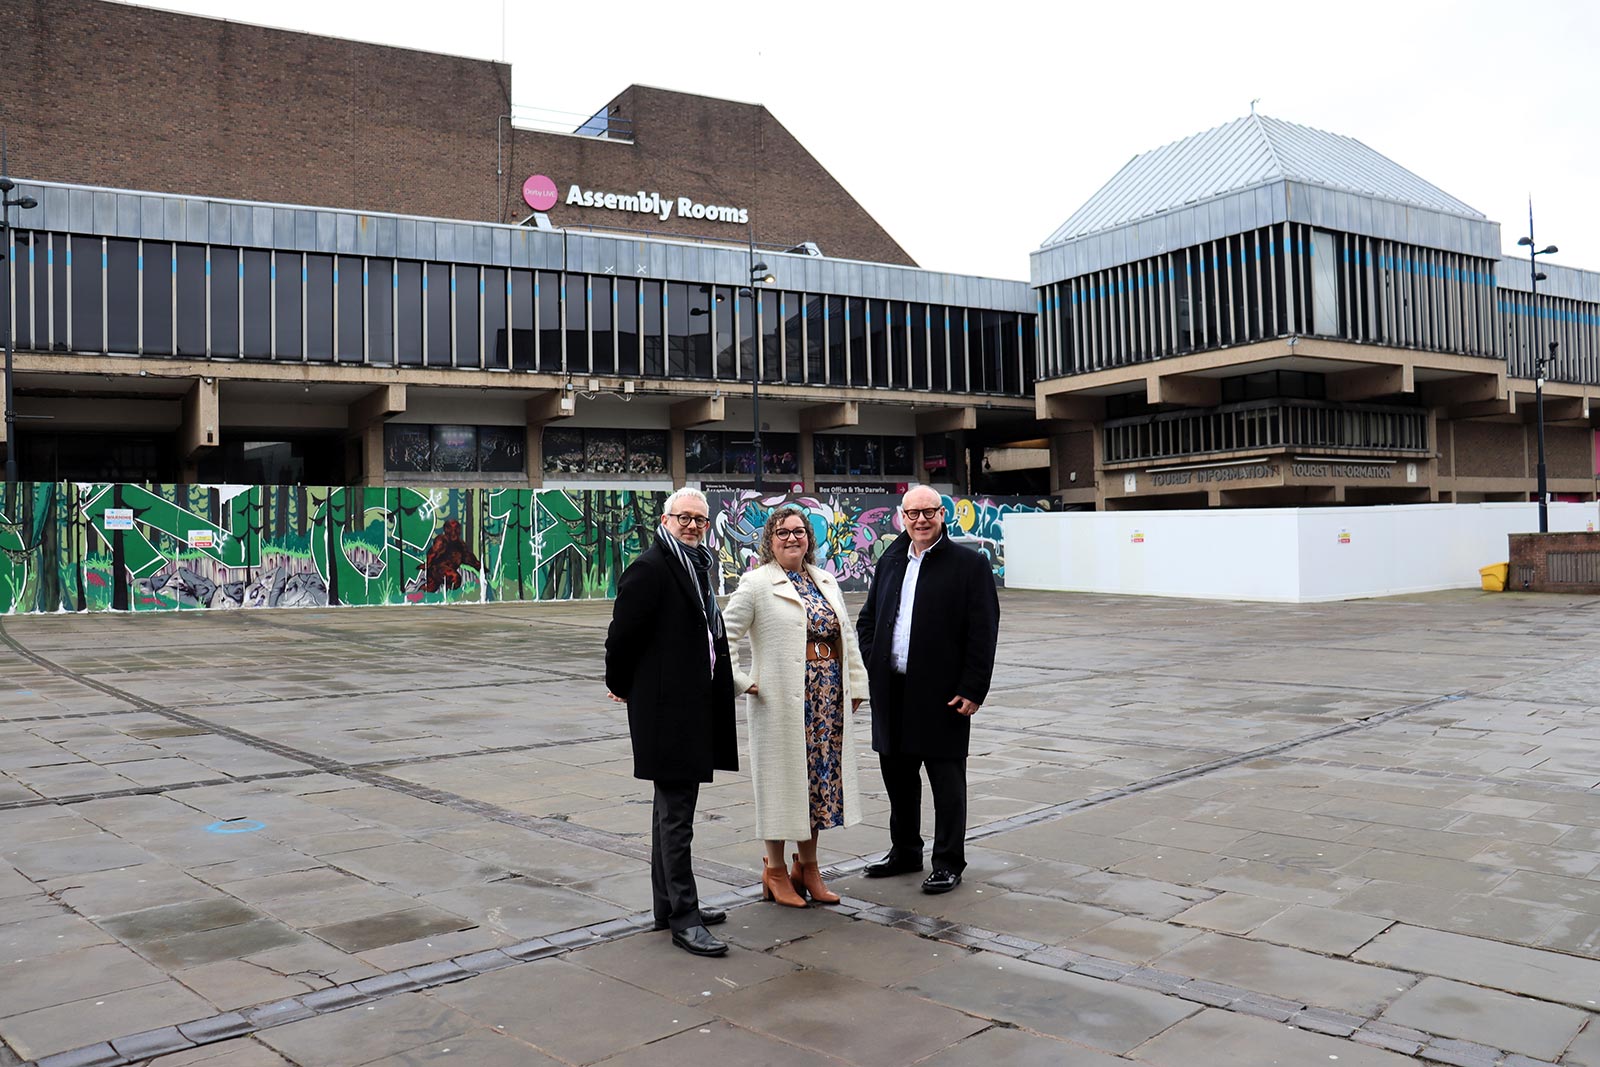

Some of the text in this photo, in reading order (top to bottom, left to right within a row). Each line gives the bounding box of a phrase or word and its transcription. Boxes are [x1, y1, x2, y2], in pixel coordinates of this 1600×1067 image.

[525, 188, 542, 197] Derby
[565, 184, 749, 224] Assembly Rooms
[1152, 465, 1275, 487] TOURIST INFORMATION
[1292, 463, 1392, 478] TOURIST INFORMATION
